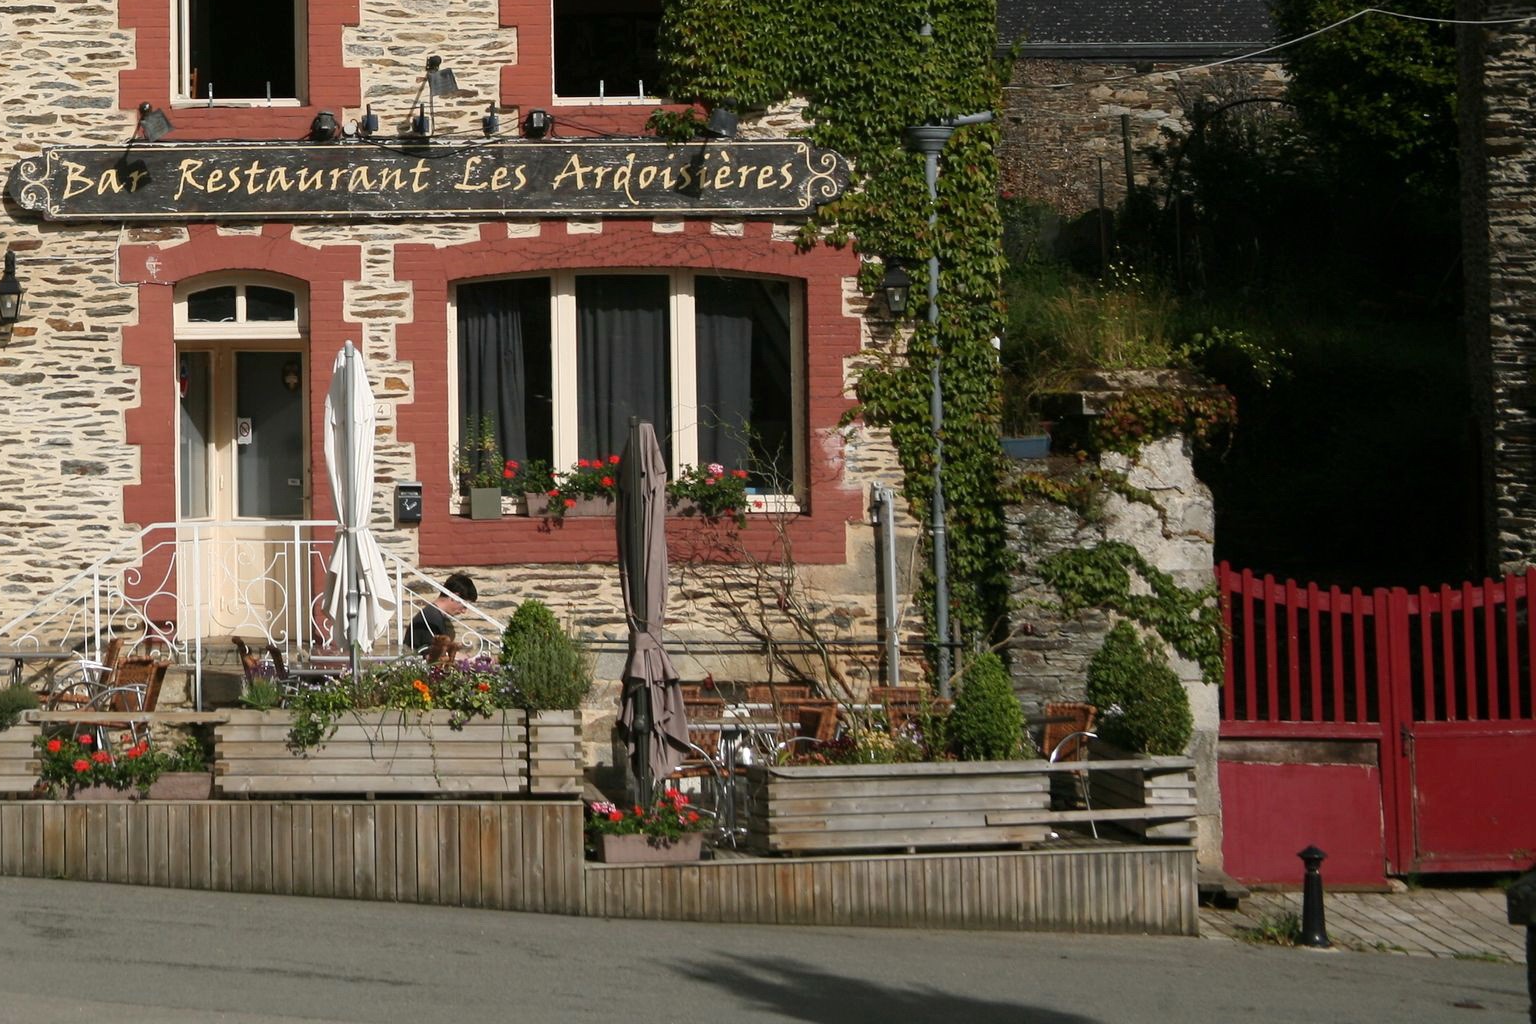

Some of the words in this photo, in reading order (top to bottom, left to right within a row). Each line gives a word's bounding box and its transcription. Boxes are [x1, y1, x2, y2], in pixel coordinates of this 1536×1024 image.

[63, 161, 148, 199] Bar
[174, 157, 432, 201] Restaurant
[454, 155, 527, 191] Les
[552, 150, 793, 205] Ardoisières
[377, 404, 384, 415] 4
